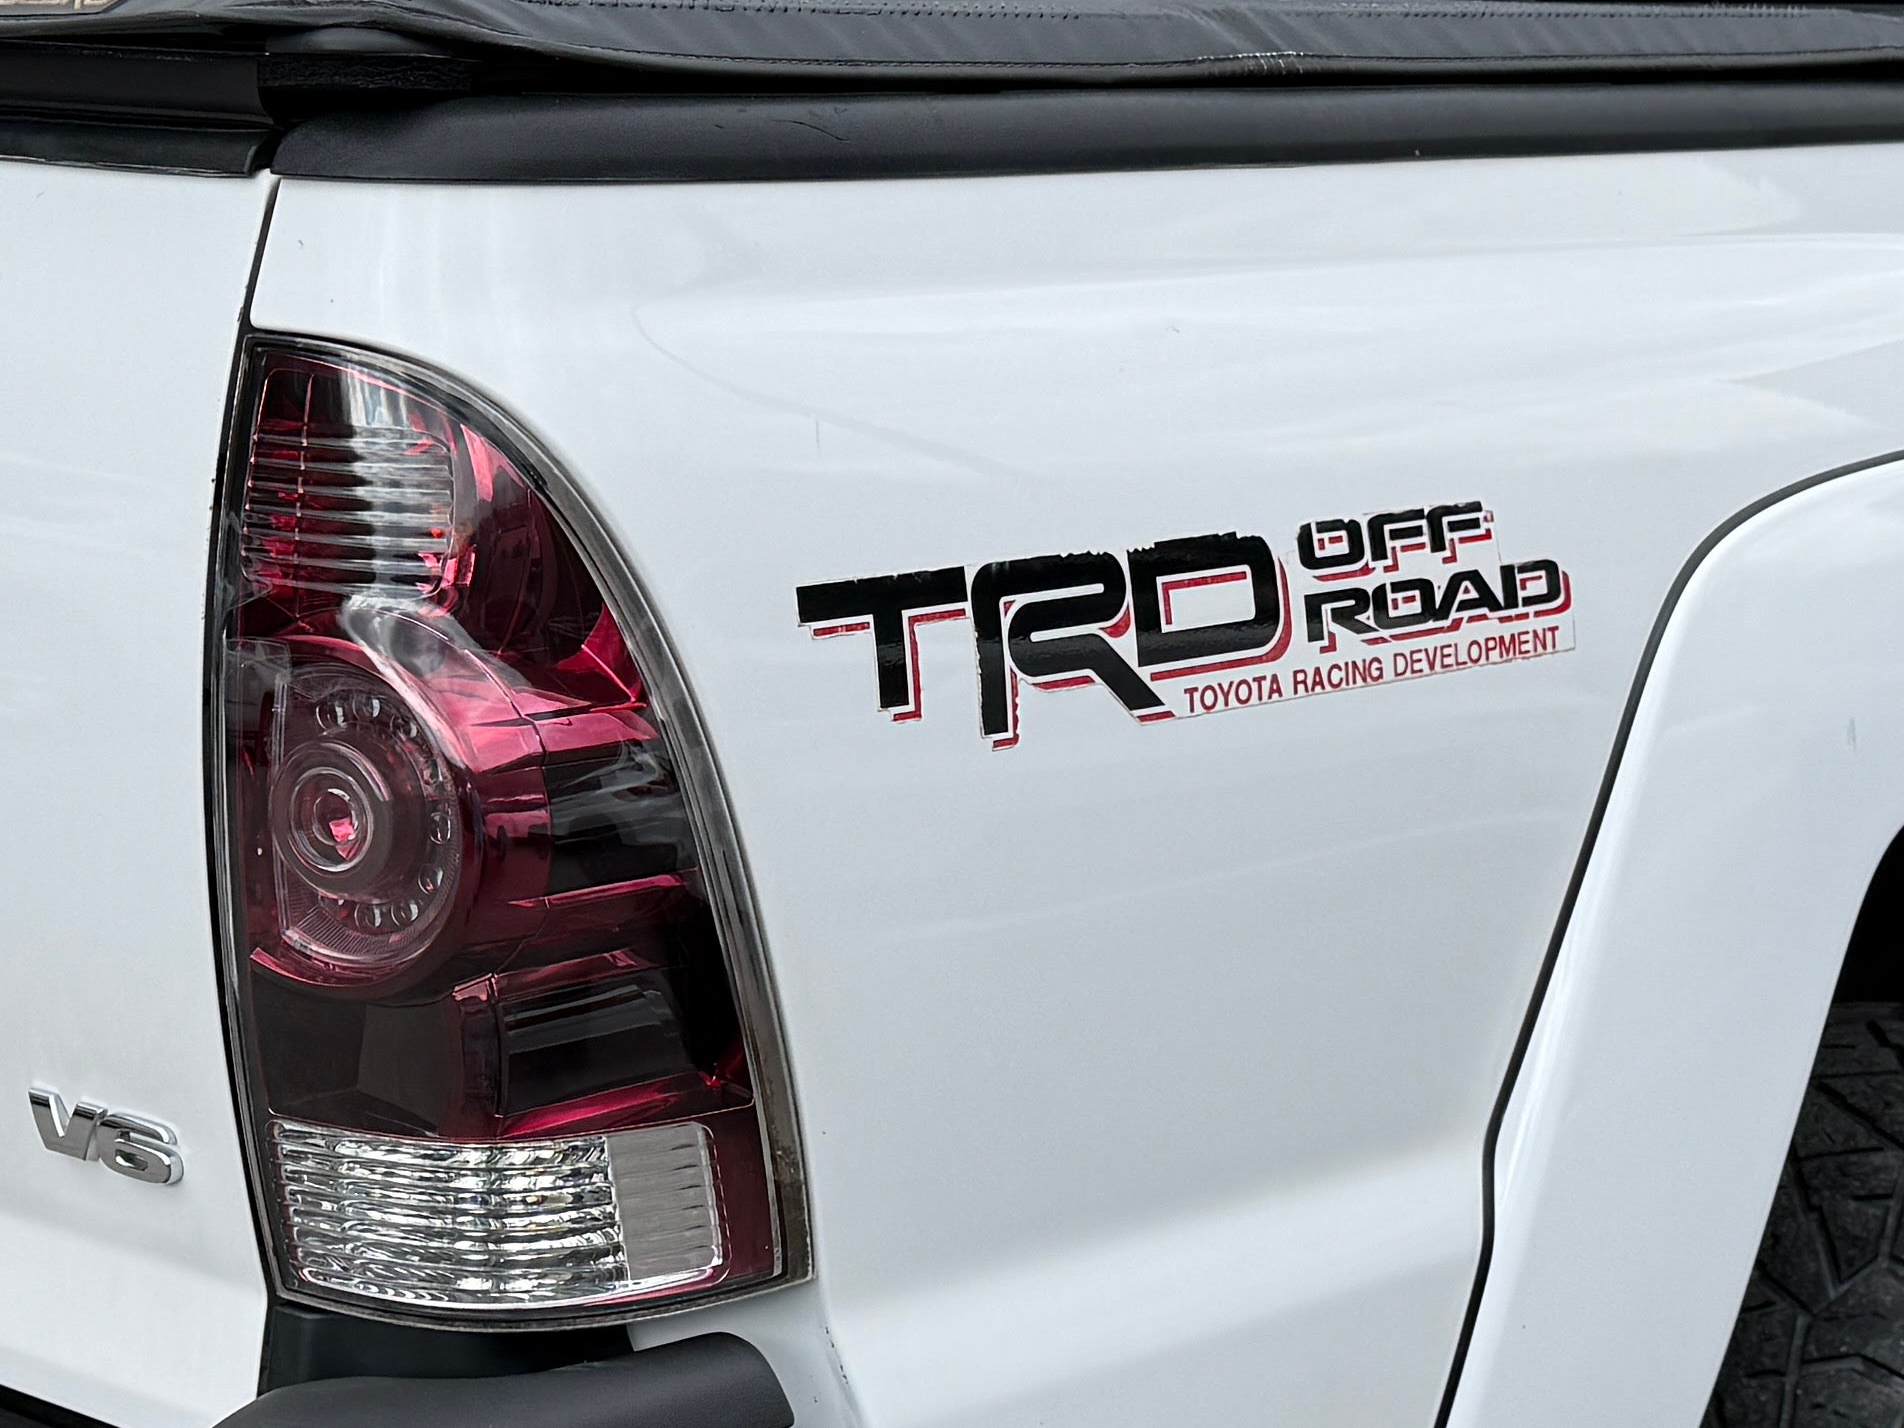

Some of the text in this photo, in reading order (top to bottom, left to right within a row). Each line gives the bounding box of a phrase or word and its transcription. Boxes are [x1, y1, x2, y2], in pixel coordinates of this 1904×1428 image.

[1296, 500, 1495, 581] OFF
[795, 529, 1292, 752] TRD
[1305, 559, 1573, 653] ROAD
[1183, 625, 1560, 716] TOYOTA RACING DEVELOPMENT
[27, 1086, 185, 1186] V6
